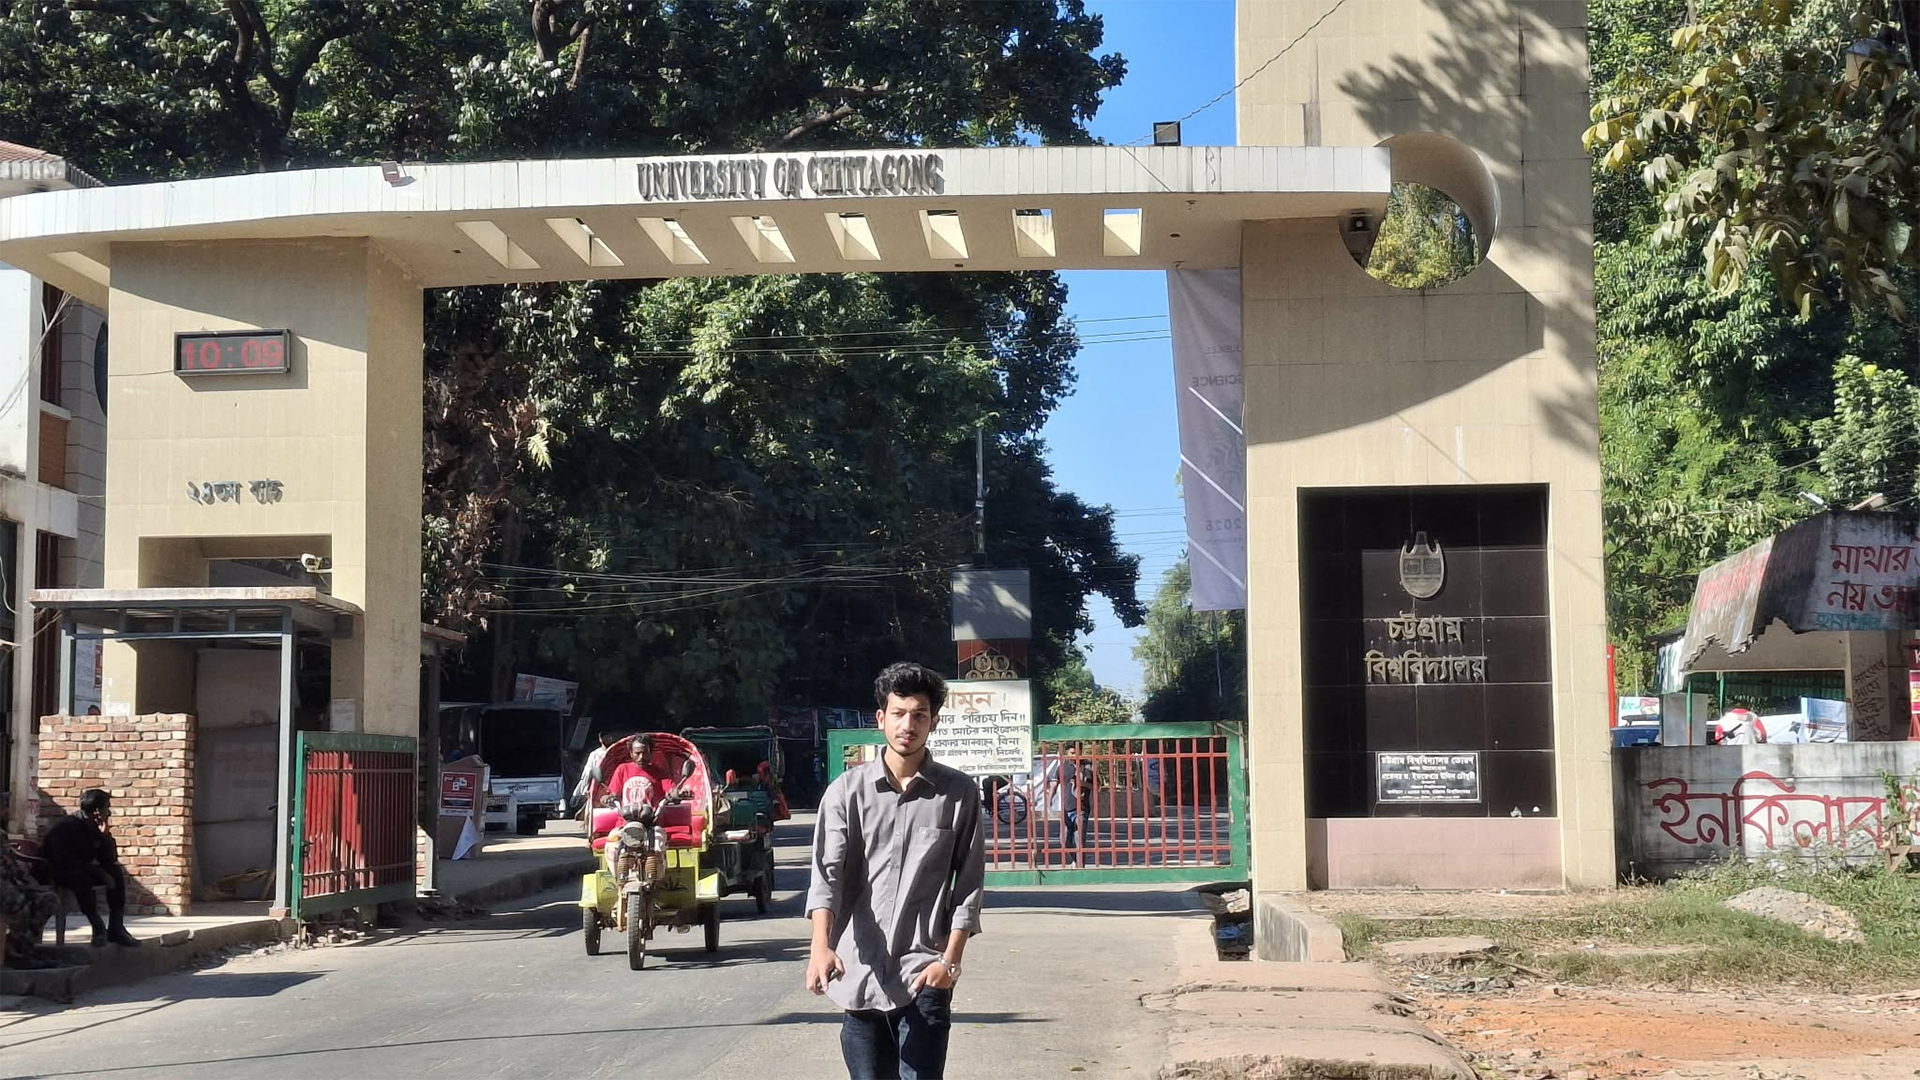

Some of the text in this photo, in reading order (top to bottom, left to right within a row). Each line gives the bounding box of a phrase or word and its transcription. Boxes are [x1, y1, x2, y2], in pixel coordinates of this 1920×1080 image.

[636, 153, 945, 201] UNIVERSITY OF CHITTAGONG
[182, 339, 283, 370] 10:09
[1830, 543, 1916, 574] মাথার
[1825, 580, 1873, 612] নয়
[1383, 610, 1463, 643] চট্টগ্রাম
[1364, 650, 1487, 684] বিশ্ববিদ্যালয়
[1648, 771, 1887, 849] ইনকিলাব
